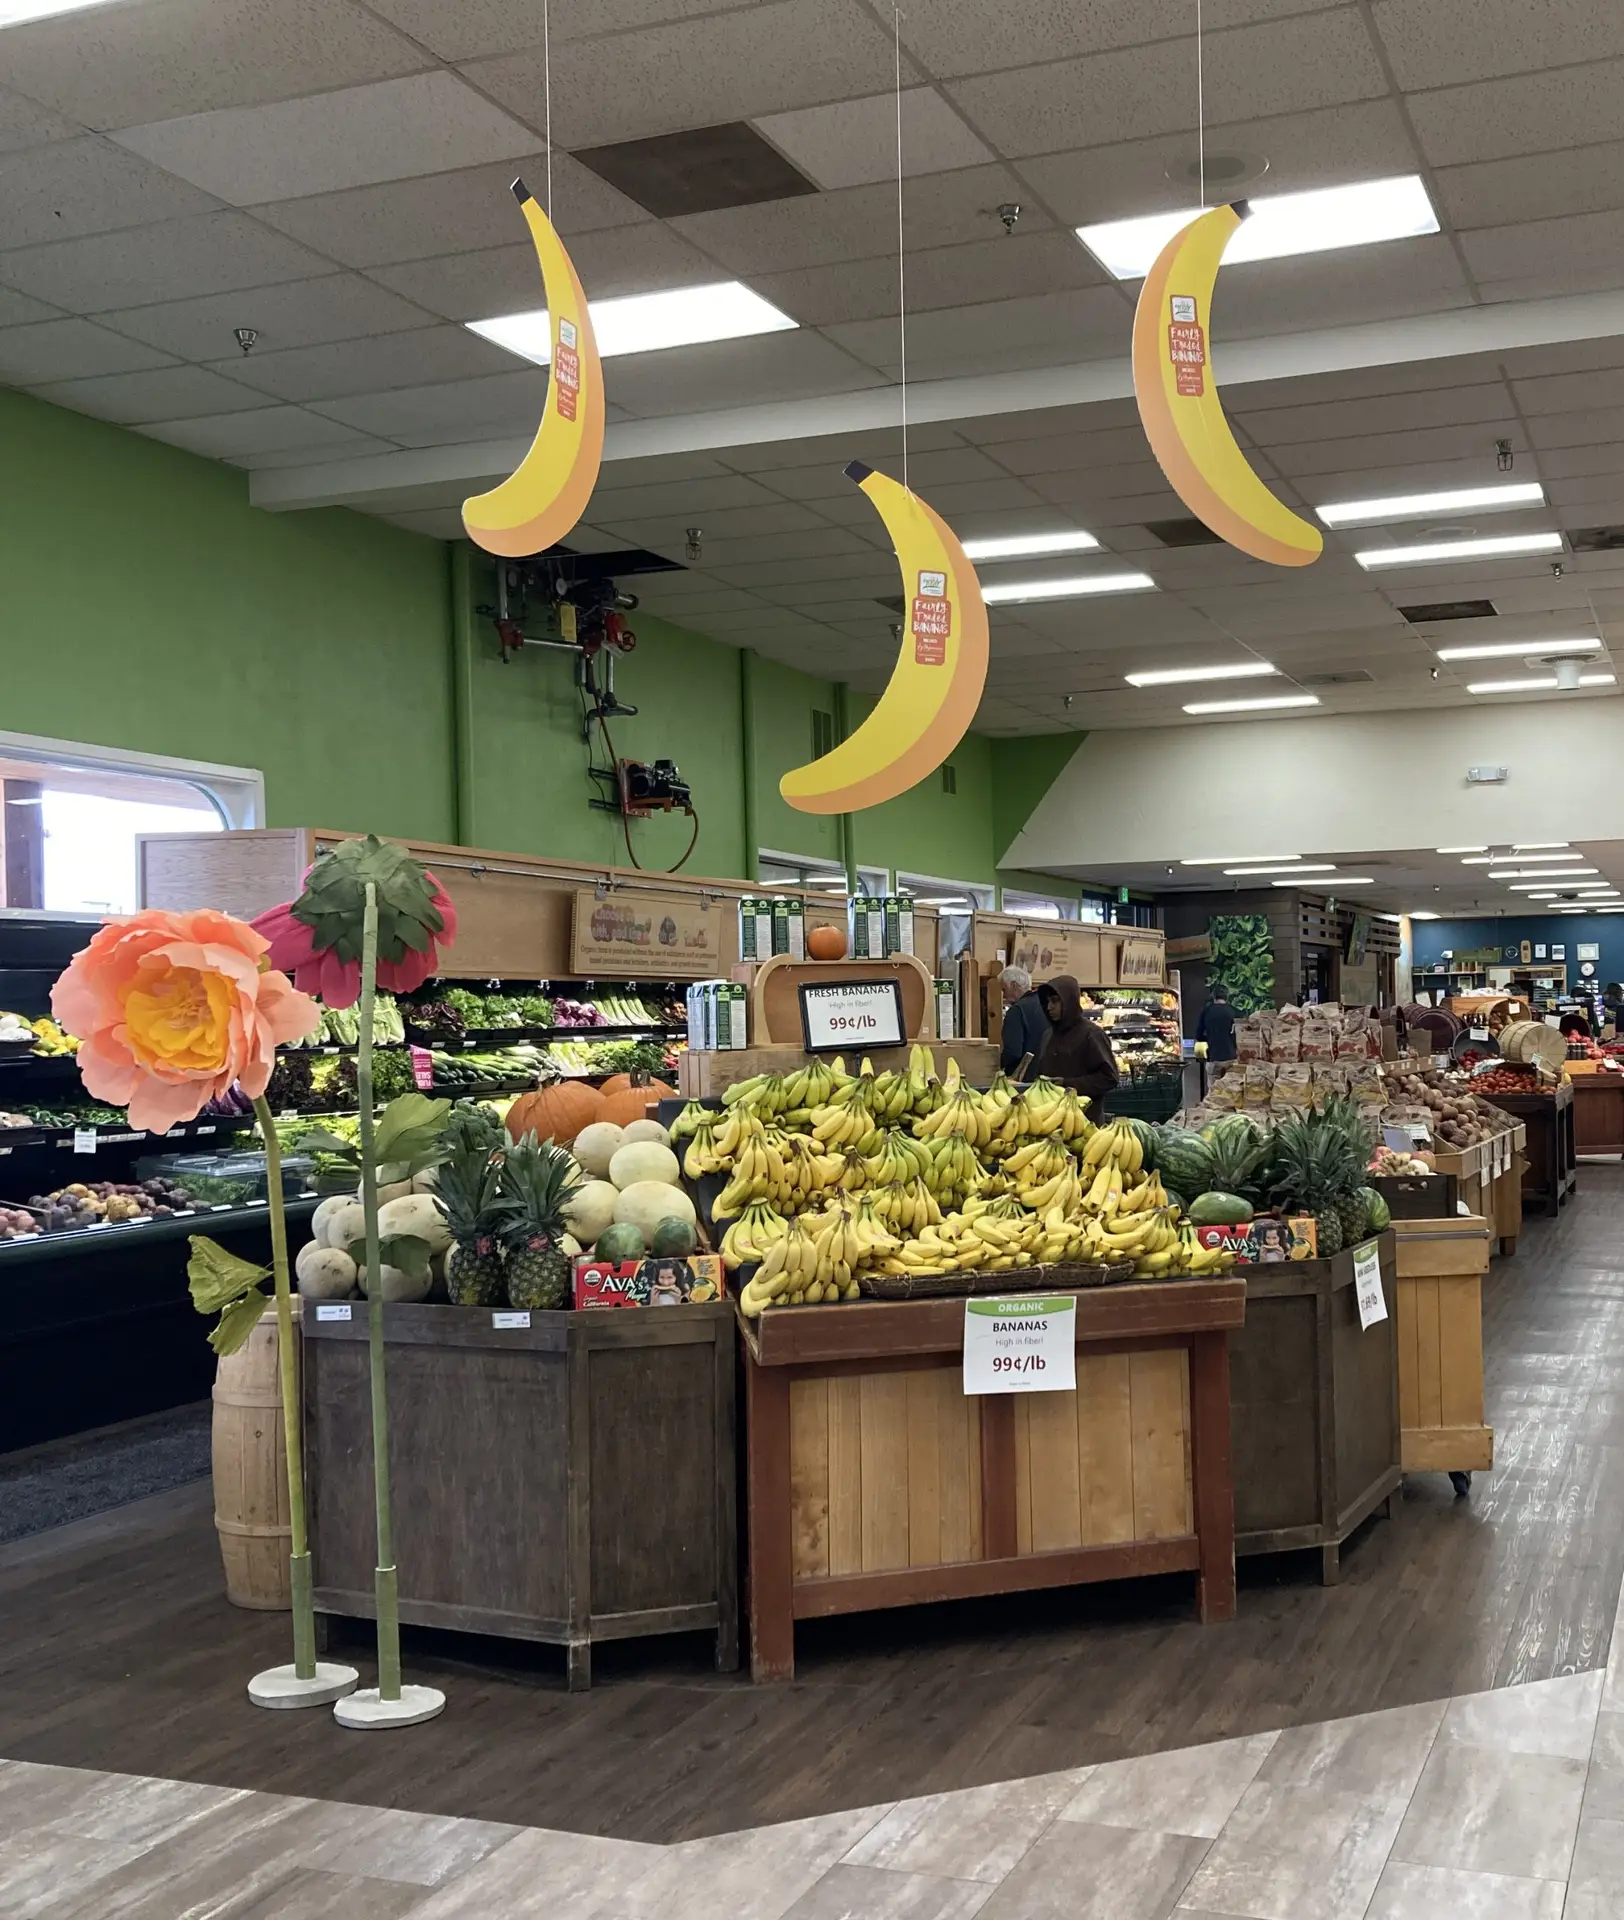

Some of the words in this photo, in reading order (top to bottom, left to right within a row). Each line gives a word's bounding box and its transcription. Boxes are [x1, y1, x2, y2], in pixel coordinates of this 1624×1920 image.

[809, 989, 839, 998] FRESH
[842, 986, 890, 996] BANANAS
[830, 1015, 877, 1030] 99¢/lb
[998, 1302, 1045, 1312] ORGANIC
[993, 1320, 1048, 1333] BANANAS
[995, 1338, 1013, 1348] High
[1024, 1336, 1044, 1345] fiber!
[992, 1355, 1046, 1373] 99¢/lb
